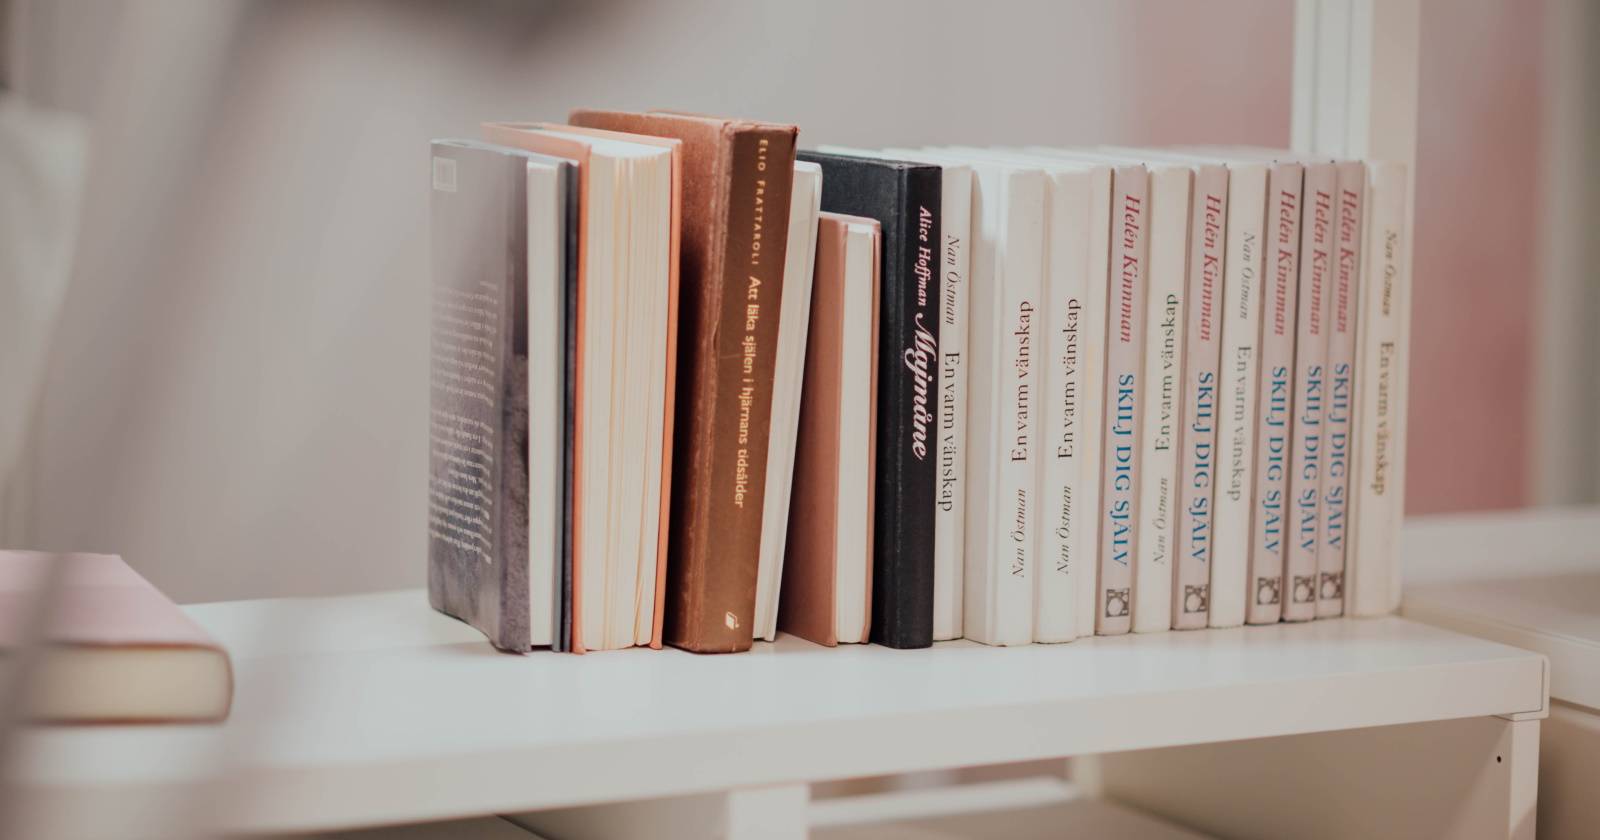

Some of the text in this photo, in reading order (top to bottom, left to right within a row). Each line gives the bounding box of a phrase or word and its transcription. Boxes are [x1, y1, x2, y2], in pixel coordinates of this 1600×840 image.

[752, 139, 768, 265] ELIO FRATTAROLI
[914, 206, 933, 307] Alice Hoffman
[1120, 195, 1140, 343] Helén Kinnman
[1200, 194, 1221, 341] Helén Kinnman
[1274, 190, 1295, 336] Helén Kinnman
[1310, 190, 1330, 336] Helén Kinnman
[1336, 189, 1357, 334] Helén Kinnman
[945, 235, 961, 325] Nan Östman
[1014, 301, 1033, 379] vänskap
[1062, 299, 1081, 377] vänskap
[1161, 294, 1179, 370] vänskap
[734, 276, 761, 509] Att läka själen i hjärnans tidsålder
[904, 313, 936, 460] Majmåne
[1324, 363, 1349, 550] SKILJ DIG SJÄLV
[937, 435, 957, 512] vänskap
[1055, 486, 1072, 574] Nan Östman
[1109, 374, 1134, 566] SKILJ DIG SJÄLV
[1153, 477, 1168, 564] Nan Östman
[1189, 372, 1214, 562] SKILJ DIG SJÄLV
[1226, 425, 1245, 501] vänskap
[1262, 367, 1287, 555] SKILJ DIG SJÄLV
[1298, 366, 1322, 553] SKILJ DIG SJÄLV
[1011, 489, 1026, 578] Nan Östman
